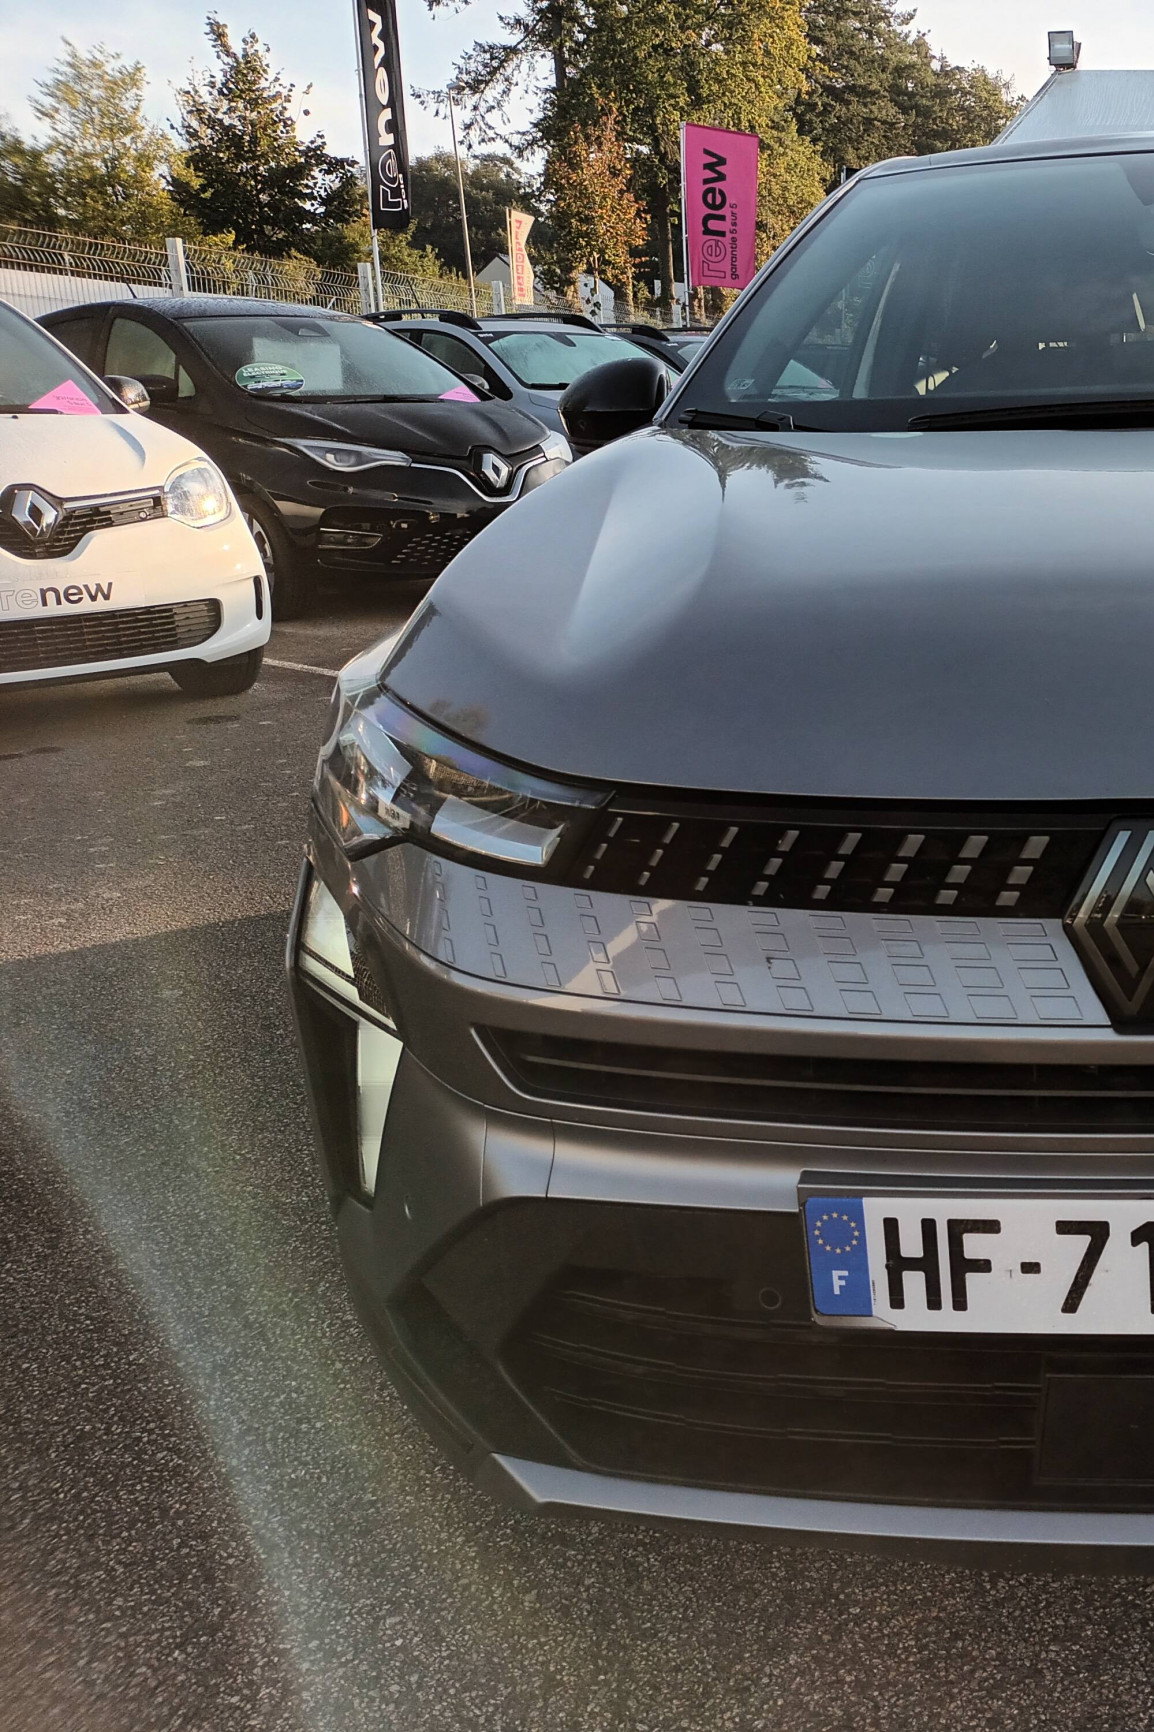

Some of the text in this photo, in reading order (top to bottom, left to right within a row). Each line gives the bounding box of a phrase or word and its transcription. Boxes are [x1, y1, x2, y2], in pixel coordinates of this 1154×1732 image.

[367, 8, 402, 212] renew
[702, 148, 727, 279] renew
[730, 237, 739, 280] garantie
[0, 582, 113, 612] renew
[832, 1270, 849, 1295] F
